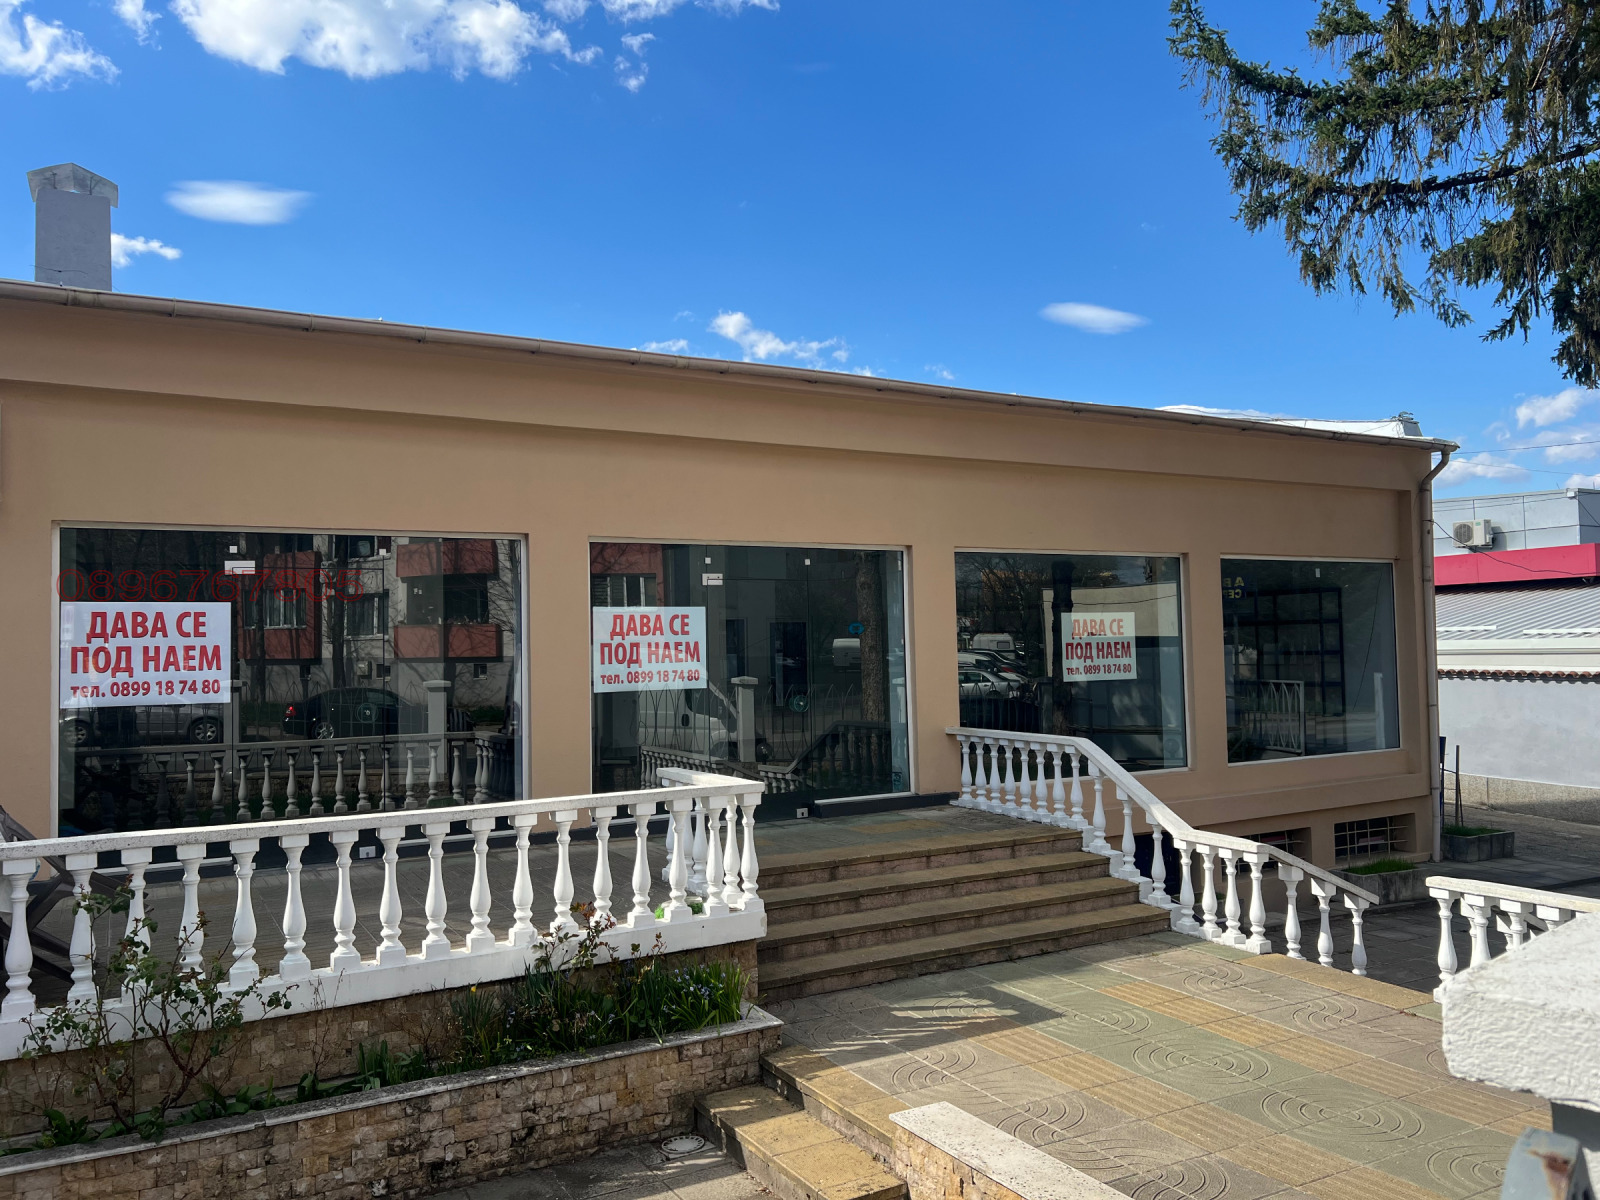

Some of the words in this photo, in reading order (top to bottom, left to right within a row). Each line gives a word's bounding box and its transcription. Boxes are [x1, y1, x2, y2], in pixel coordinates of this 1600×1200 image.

[86, 611, 168, 644] ДАВА
[175, 611, 207, 638] СЕ
[610, 614, 664, 641] ДАВА
[669, 614, 690, 636] СЕ
[1072, 619, 1107, 640] ДАВА
[1109, 618, 1124, 636] СЕ
[70, 646, 134, 679] ПОД
[142, 644, 222, 673] НАЕМ
[600, 641, 643, 669] ПОД
[647, 641, 700, 664] НАЕМ
[1065, 642, 1094, 663] ПОД
[1096, 641, 1132, 659] НАЕМ
[600, 674, 624, 685] тел.
[626, 671, 654, 683] 0899
[656, 670, 669, 683] 18
[672, 669, 685, 682] 74
[687, 669, 700, 682] 80
[1066, 667, 1082, 676] тел.
[1083, 664, 1101, 675] 0899
[1103, 664, 1112, 674] 18
[1112, 663, 1121, 674] 74
[1122, 663, 1132, 673] 80
[70, 685, 106, 698] тел.
[110, 681, 150, 697] 0899
[155, 680, 175, 696] 18
[178, 679, 198, 695] 74
[201, 679, 221, 694] 80
